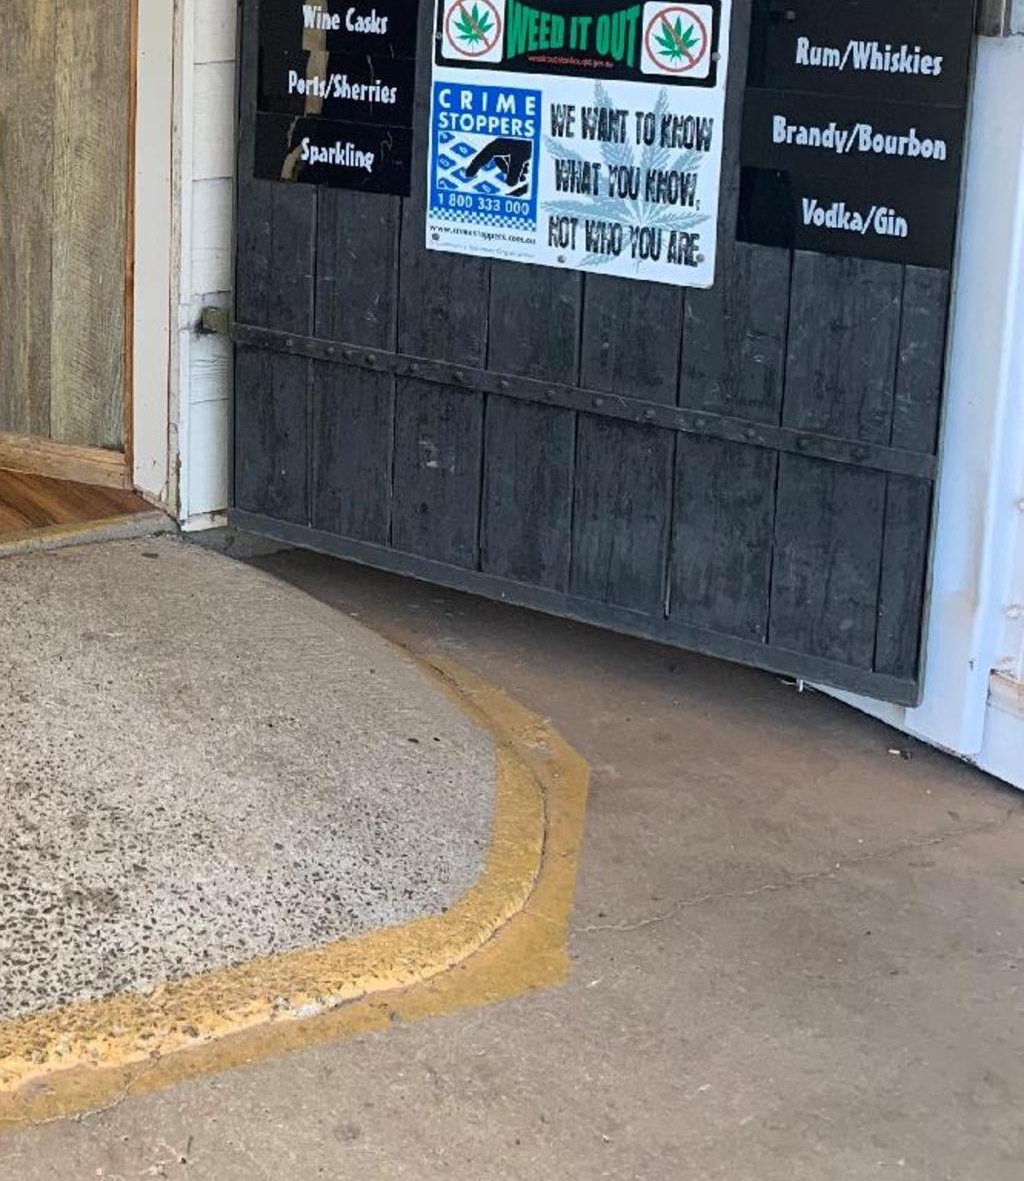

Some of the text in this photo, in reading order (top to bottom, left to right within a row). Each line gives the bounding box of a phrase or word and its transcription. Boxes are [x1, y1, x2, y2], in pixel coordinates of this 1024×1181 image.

[302, 4, 388, 35] Wine Casks
[569, 16, 593, 51] IT
[596, 3, 641, 68] OUT
[795, 36, 943, 77] Rum/Whiskies
[288, 70, 397, 105] Ports/Sherries
[438, 88, 536, 116] CRIME
[438, 111, 536, 138] STOPPERS
[550, 103, 714, 152] WE WANT TO KNOW
[772, 115, 947, 161] Brandy/Bourbon
[300, 136, 374, 173] Sparkling
[555, 159, 601, 196] WHAT
[608, 164, 640, 201] YOU
[437, 193, 530, 215] 1 800 333 000
[801, 197, 908, 239] Vodka/Gin
[548, 215, 579, 251] NOT
[585, 219, 623, 257] WHO
[628, 224, 662, 262] YOU
